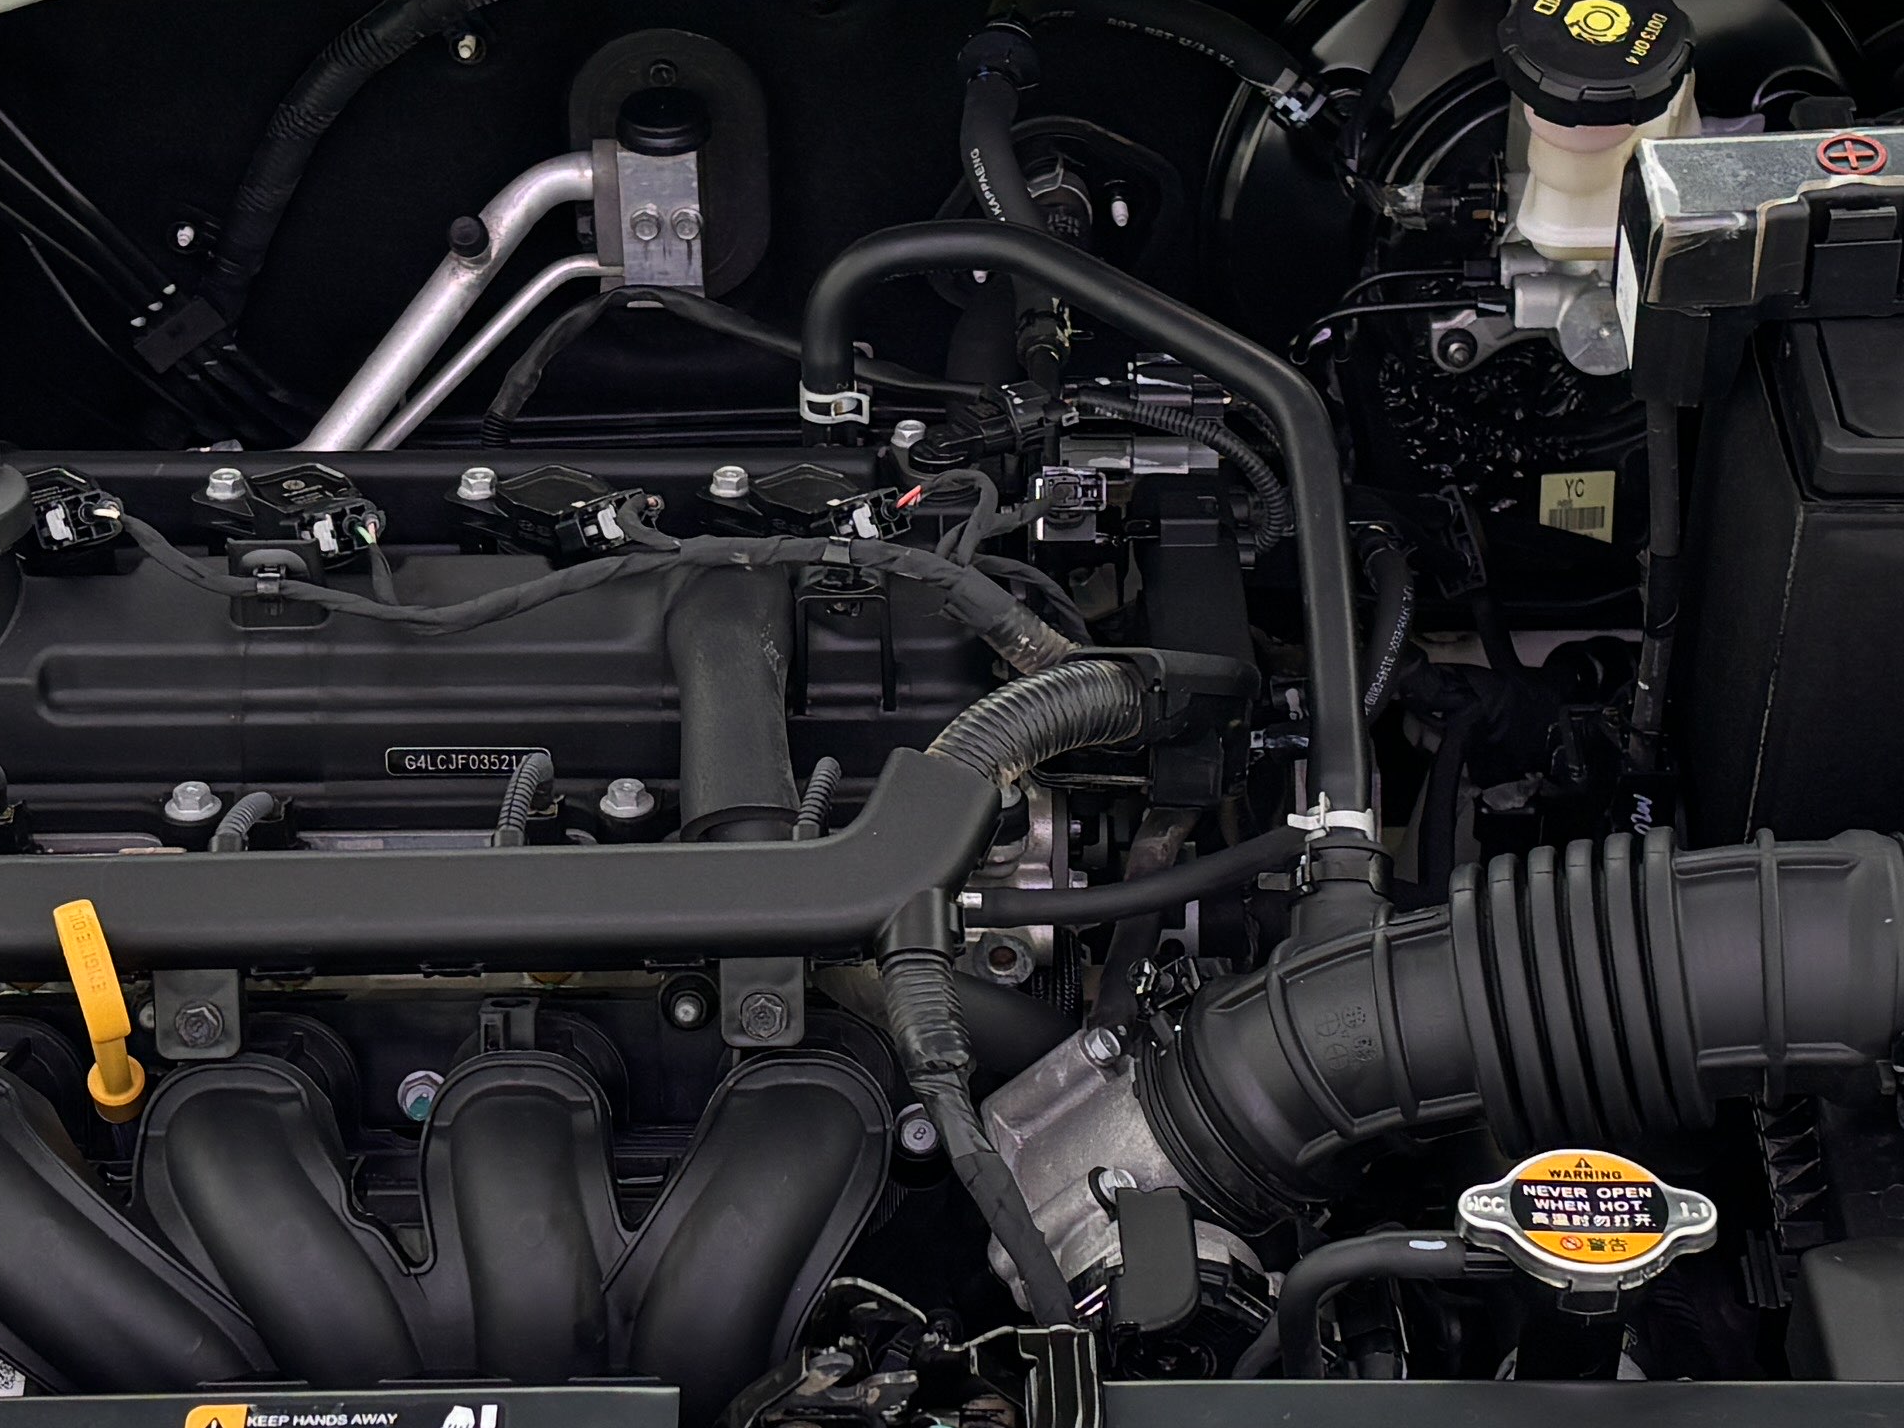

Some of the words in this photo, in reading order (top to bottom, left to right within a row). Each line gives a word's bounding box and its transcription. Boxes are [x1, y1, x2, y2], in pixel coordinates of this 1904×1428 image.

[1564, 477, 1586, 500] YC
[1548, 1168, 1624, 1181] WARNING
[1522, 1184, 1587, 1199] NEVER
[1596, 1186, 1653, 1199] OPEN
[1534, 1198, 1592, 1213] WHEN
[1586, 1237, 1629, 1253] 警告
[246, 1414, 291, 1427] KEEP
[294, 1414, 349, 1427] HANDS
[350, 1413, 399, 1426] AWAY
